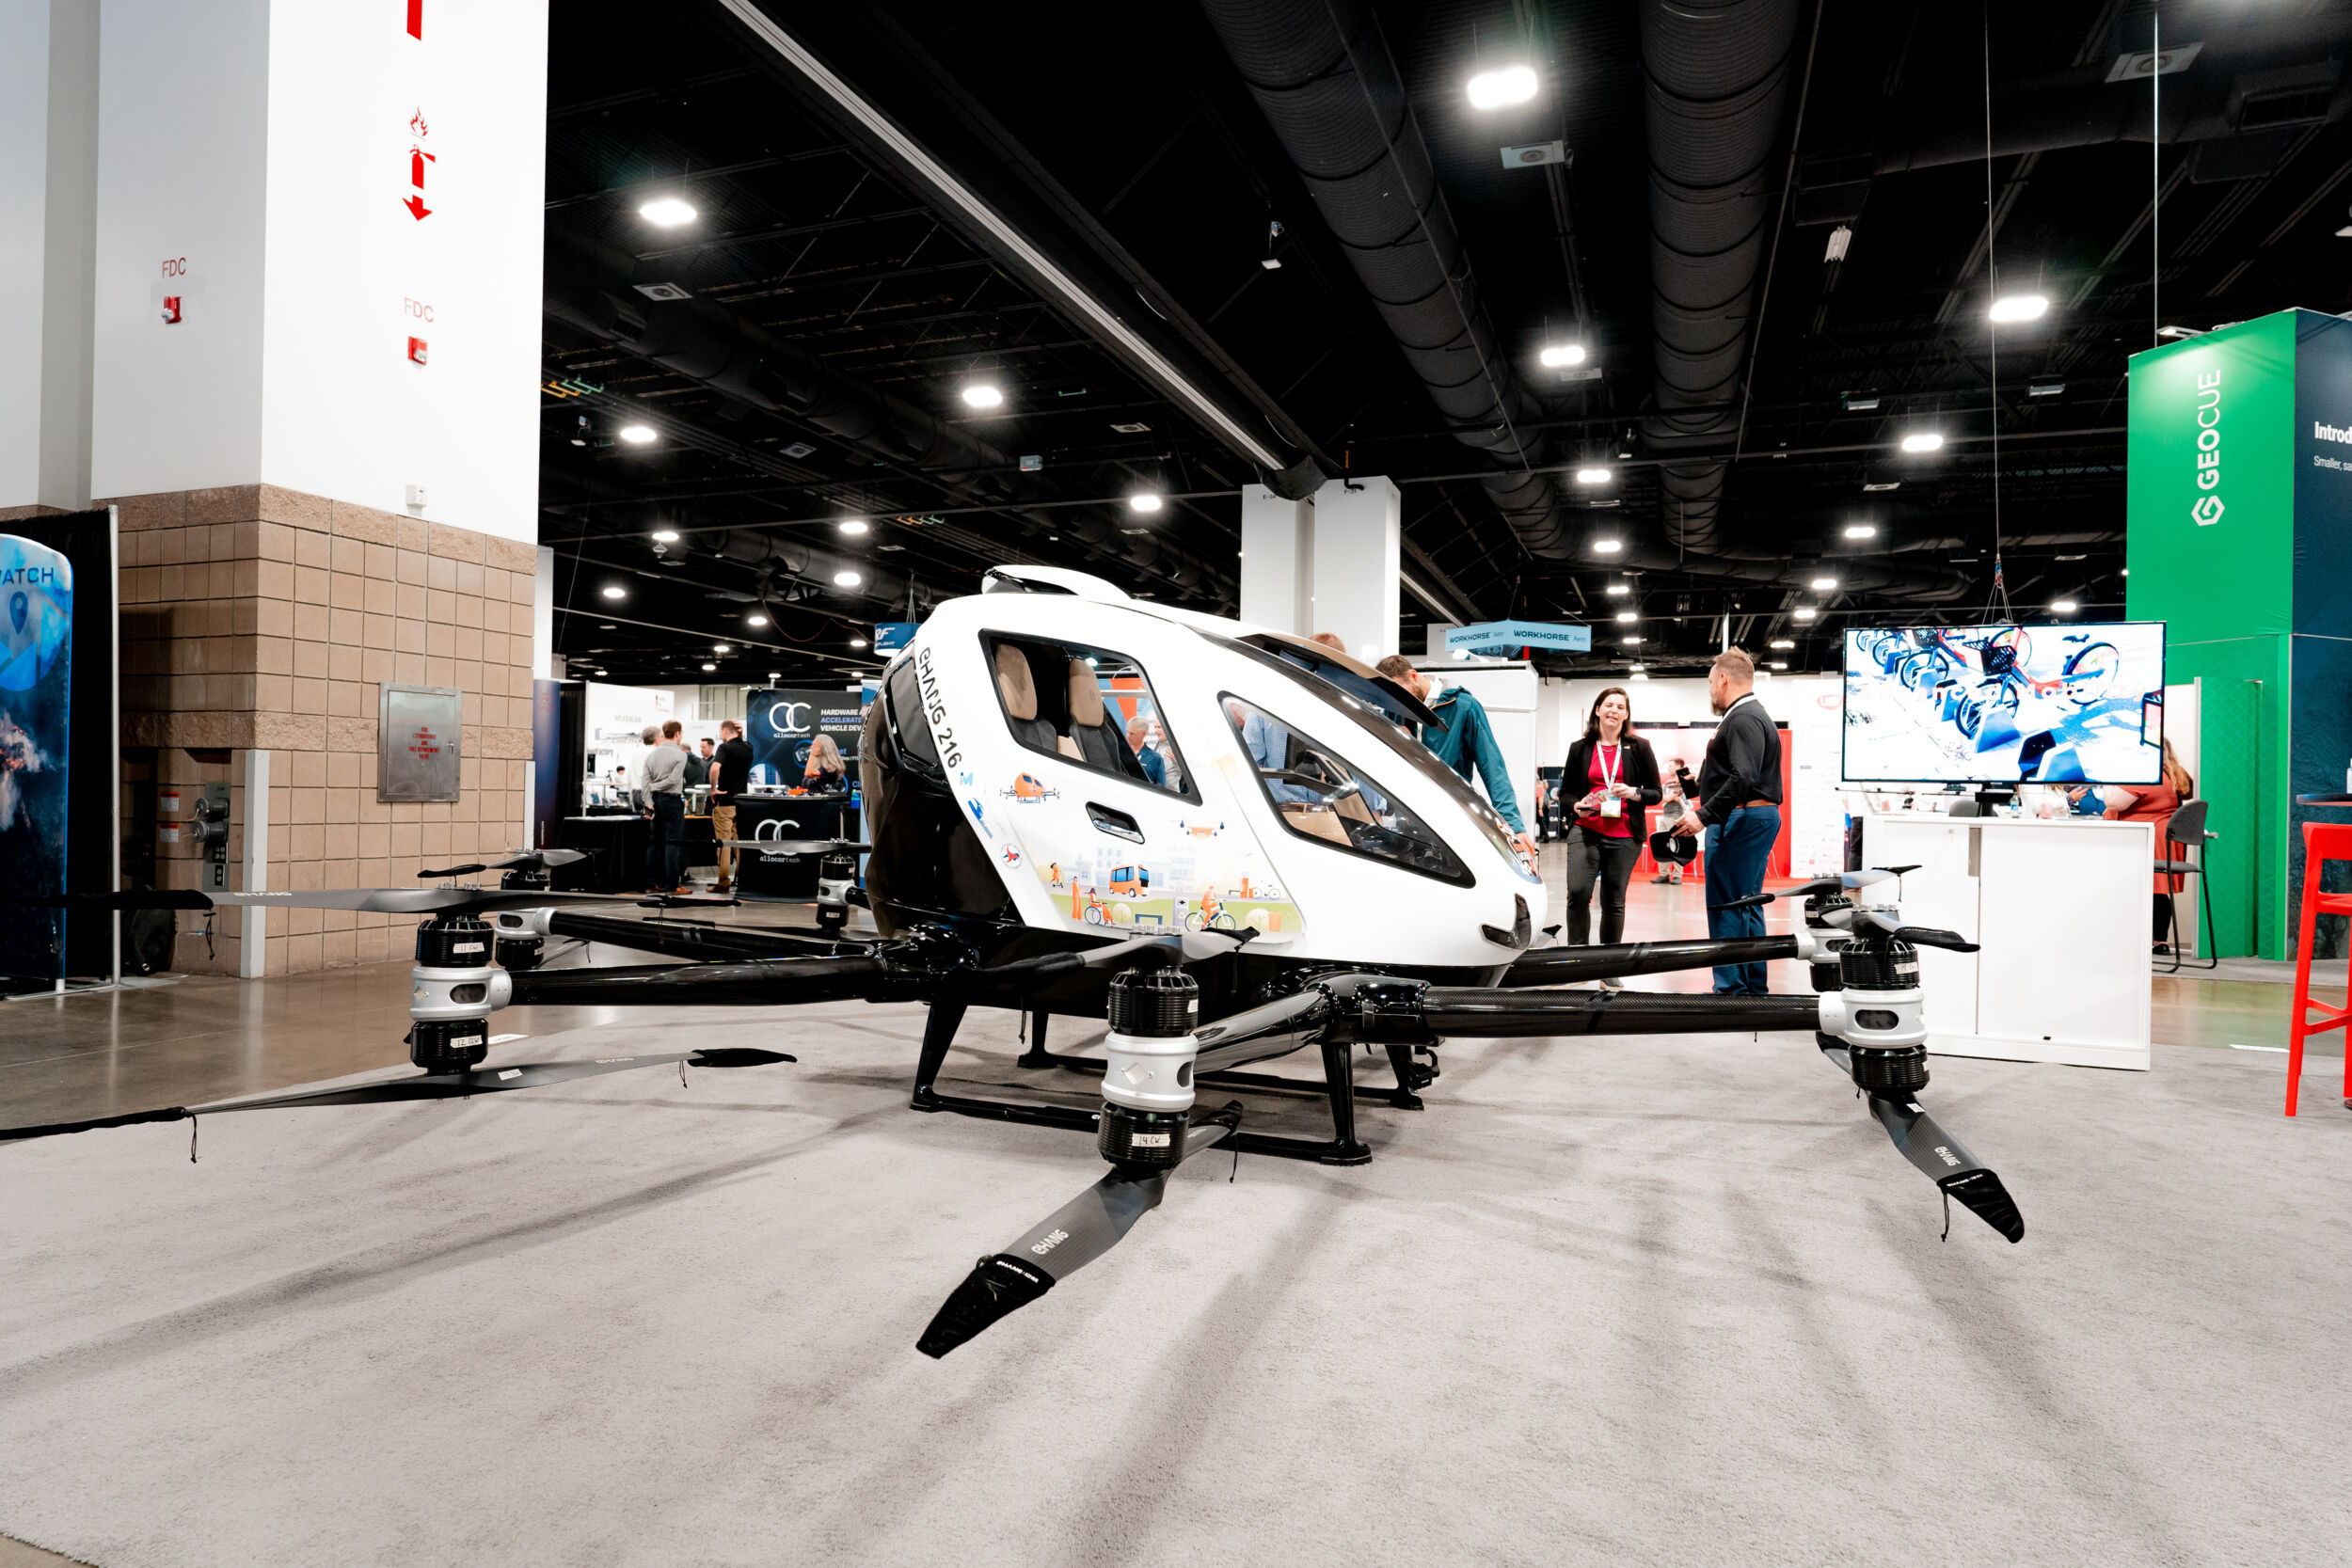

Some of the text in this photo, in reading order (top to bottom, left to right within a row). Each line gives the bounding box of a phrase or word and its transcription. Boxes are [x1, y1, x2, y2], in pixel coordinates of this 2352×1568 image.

[162, 257, 187, 278] FDC
[404, 297, 434, 323] FDC
[2197, 370, 2221, 490] GEOCUE
[2313, 421, 2352, 445] Introd
[0, 567, 54, 584] ATCH
[1513, 629, 1570, 641] WORKHORSE
[938, 727, 962, 768] 216
